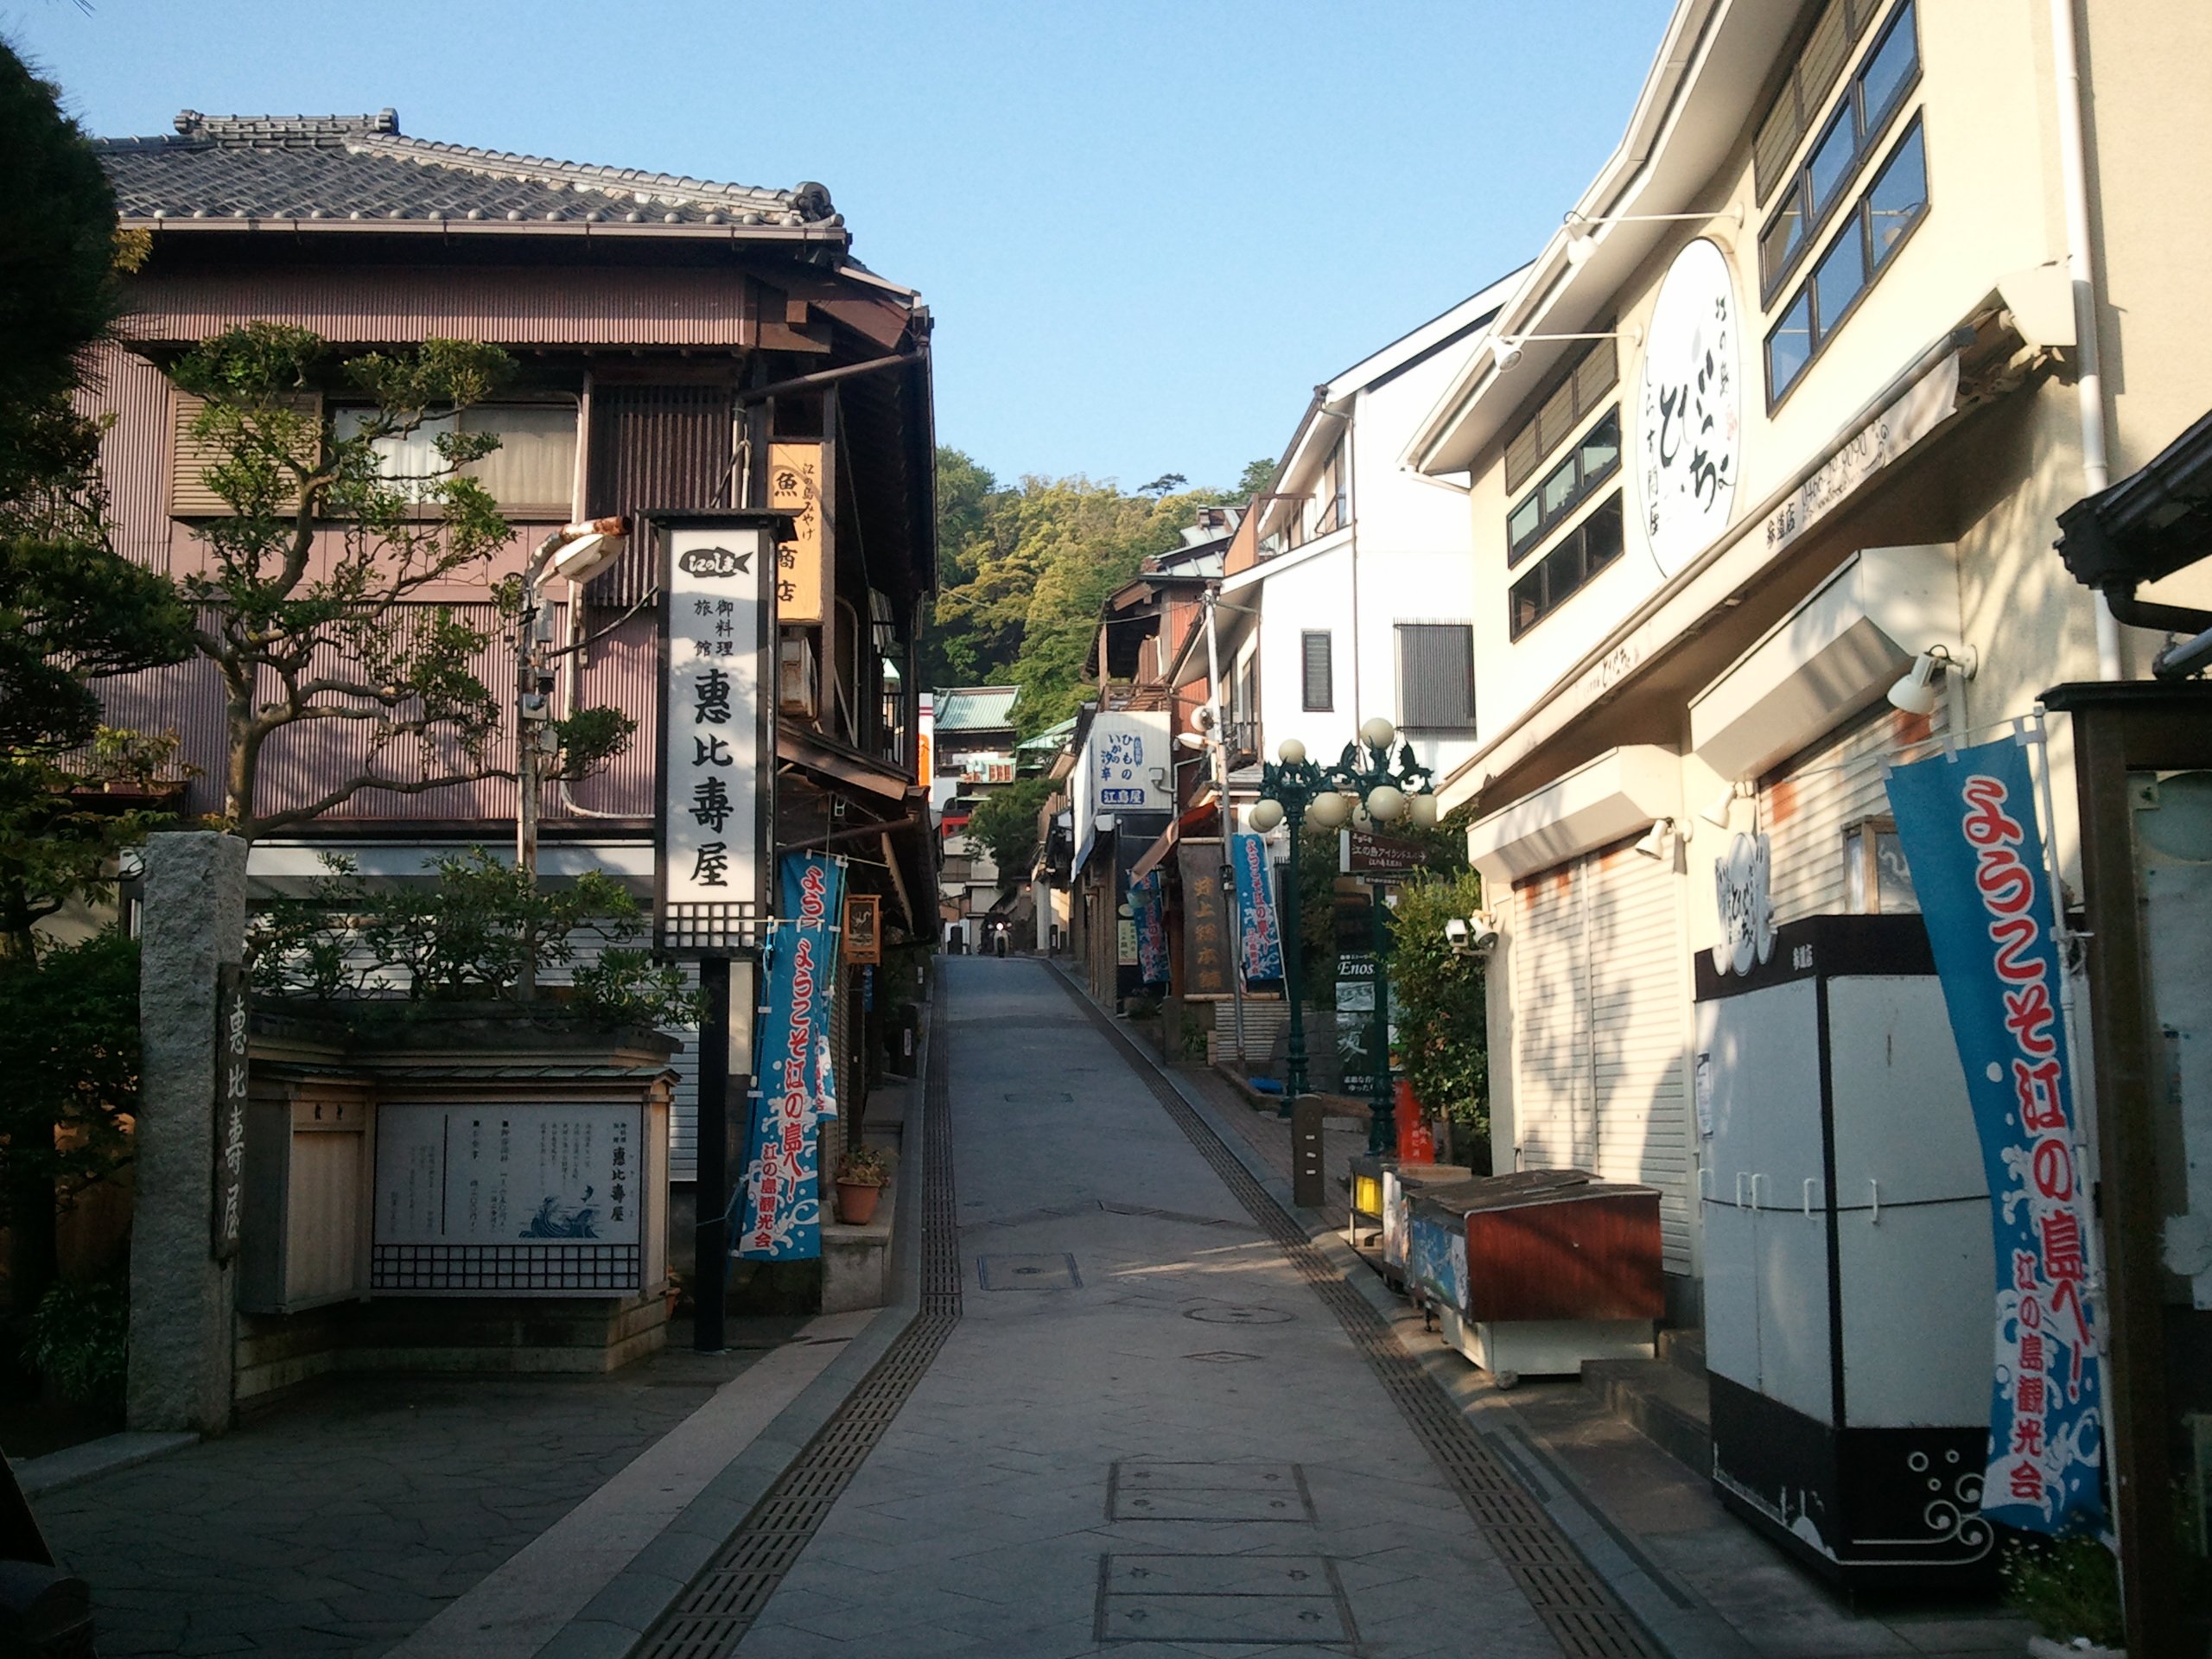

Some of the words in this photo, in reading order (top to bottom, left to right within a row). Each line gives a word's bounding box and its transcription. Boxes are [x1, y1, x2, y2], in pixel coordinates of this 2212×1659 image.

[803, 462, 816, 542] 江の島みやげ
[773, 472, 798, 602] 魚商店
[693, 599, 714, 658] 旅館
[715, 599, 735, 657] 御料理
[1122, 734, 1134, 781] ひもの
[1103, 790, 1142, 804] 江島屋
[753, 1142, 779, 1249] 江の島観光会
[2008, 1251, 2045, 1502] 江の島観光会
